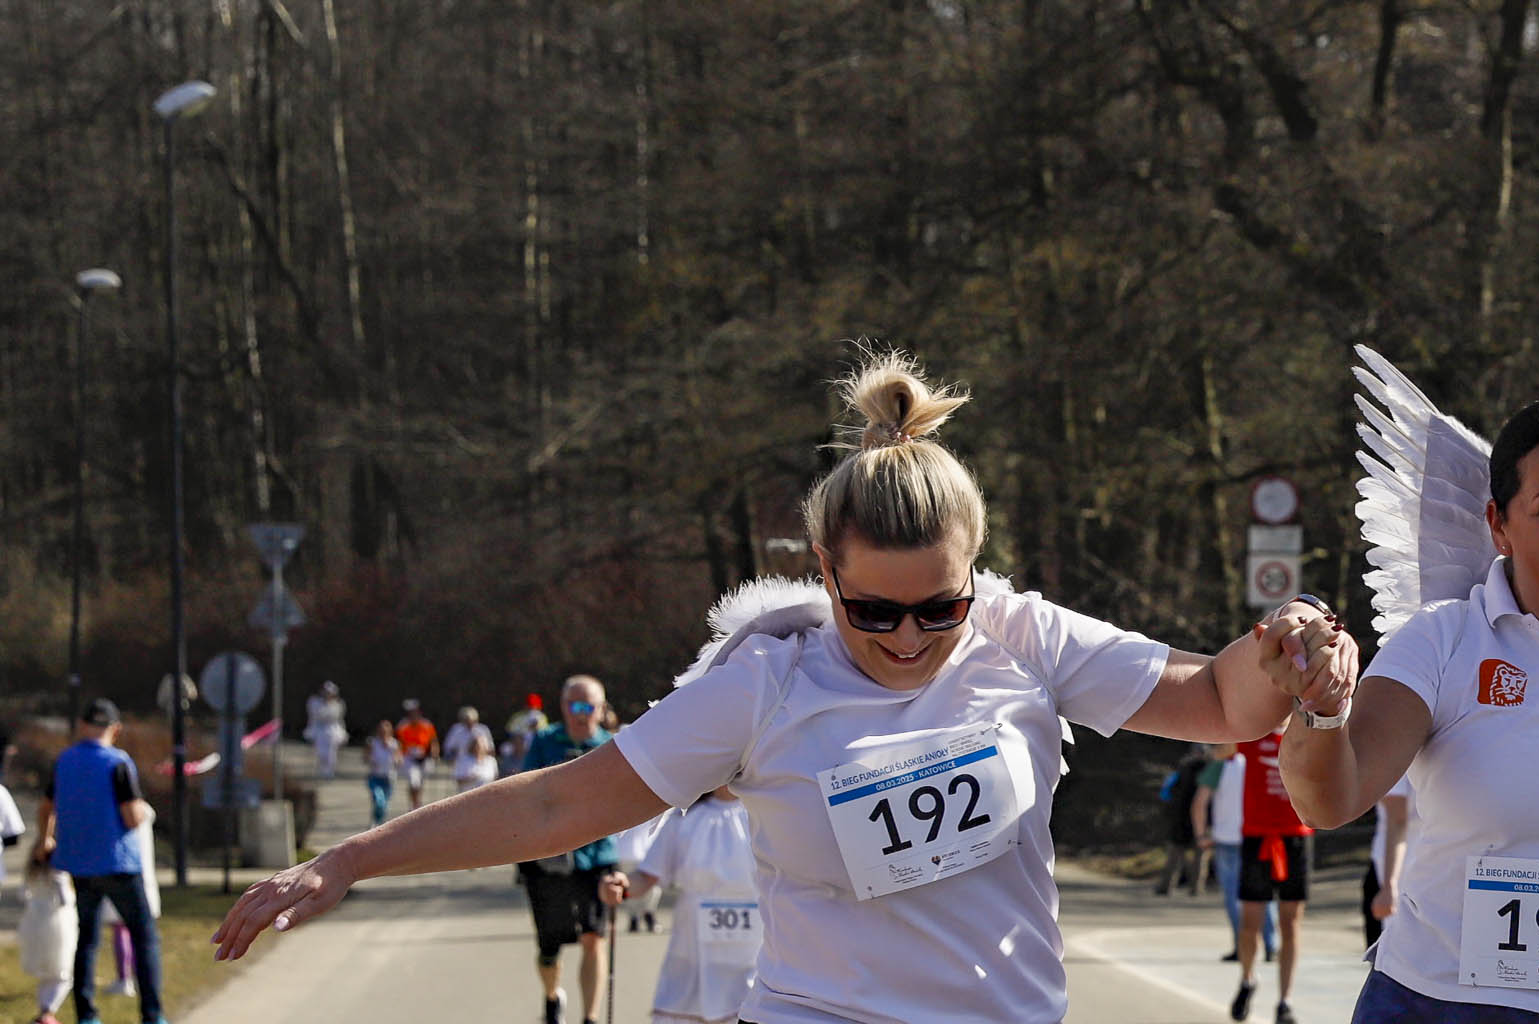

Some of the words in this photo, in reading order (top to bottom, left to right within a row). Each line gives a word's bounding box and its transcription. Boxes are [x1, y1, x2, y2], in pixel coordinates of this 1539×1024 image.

[842, 775, 859, 788] BIEG
[859, 763, 896, 783] FUNDACJI
[918, 760, 957, 779] KATOWICE
[868, 774, 991, 856] 192
[1486, 868, 1502, 878] BIEG
[1502, 869, 1537, 880] FUNDACJI
[709, 908, 751, 930] 301
